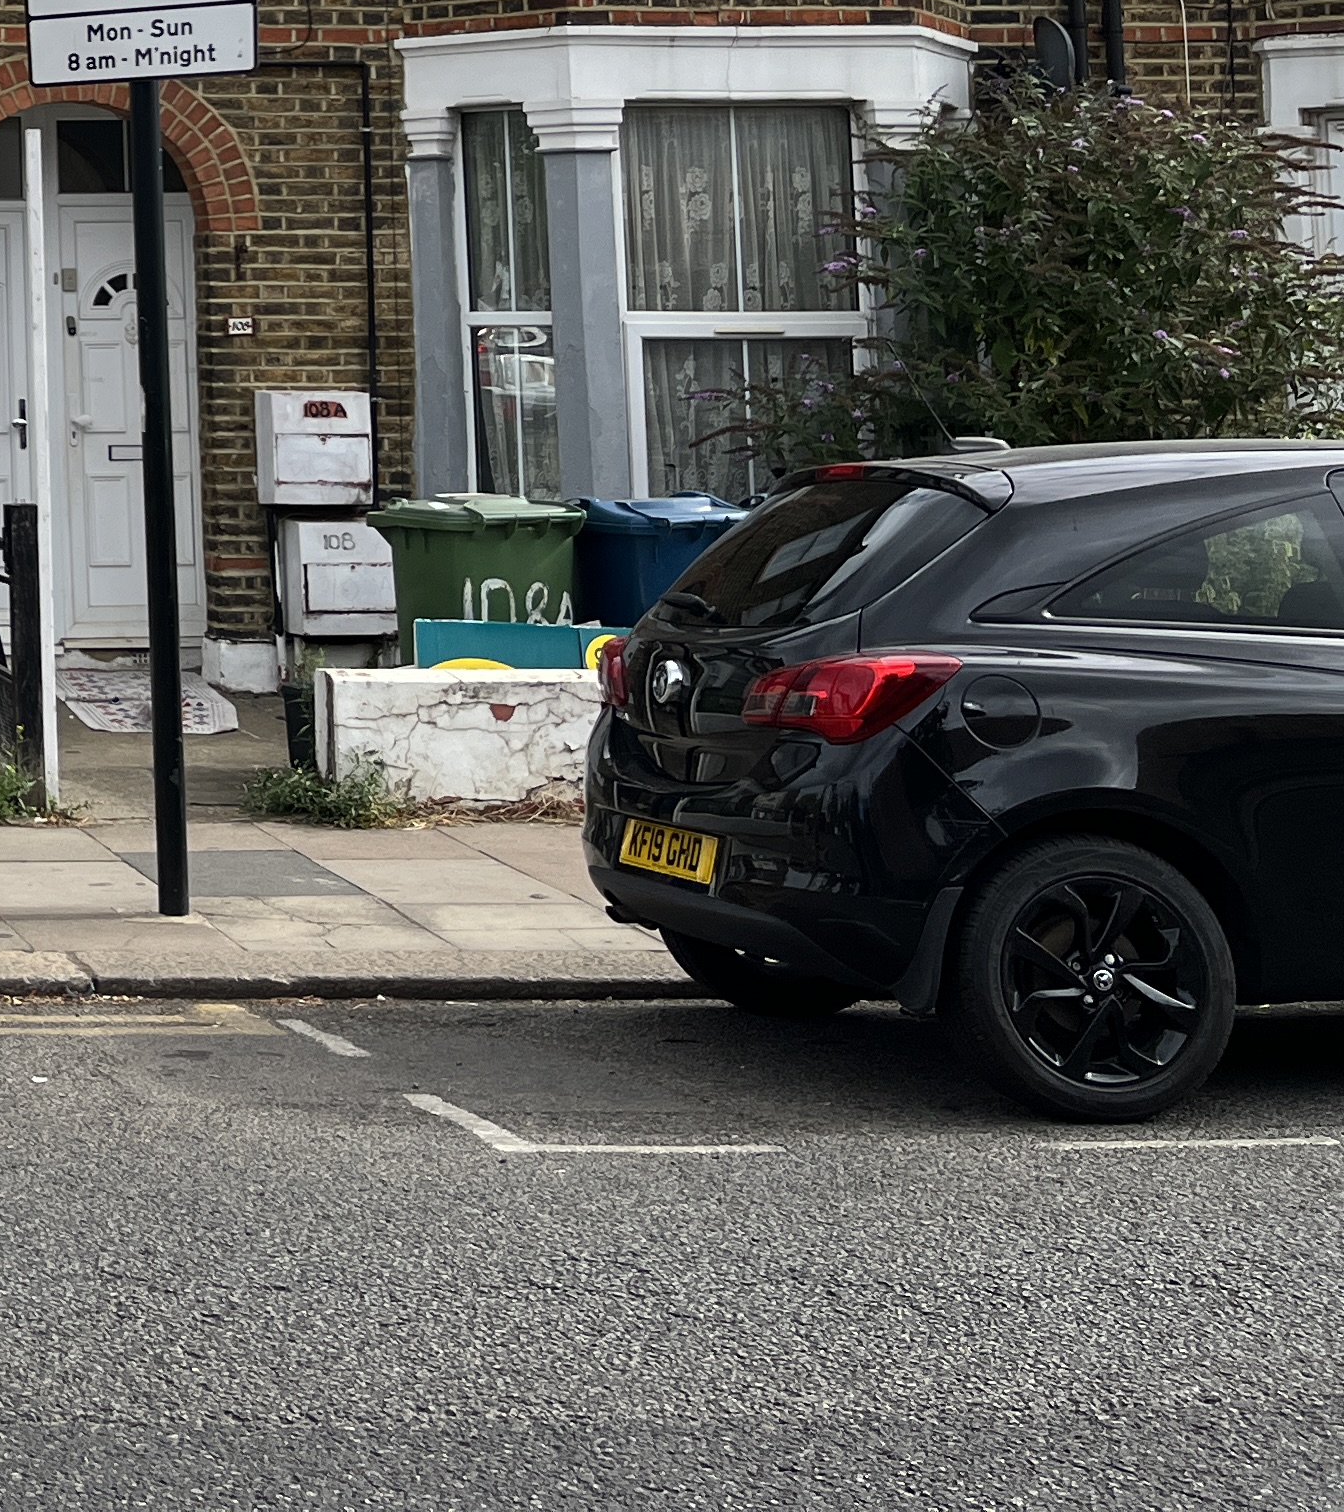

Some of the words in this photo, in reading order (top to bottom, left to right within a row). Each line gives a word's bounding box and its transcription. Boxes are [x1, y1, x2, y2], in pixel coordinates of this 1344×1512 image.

[86, 22, 131, 43] Mon
[150, 19, 193, 39] Sun
[134, 44, 216, 67] M'night
[323, 532, 356, 551] 108
[628, 822, 662, 863] KF19
